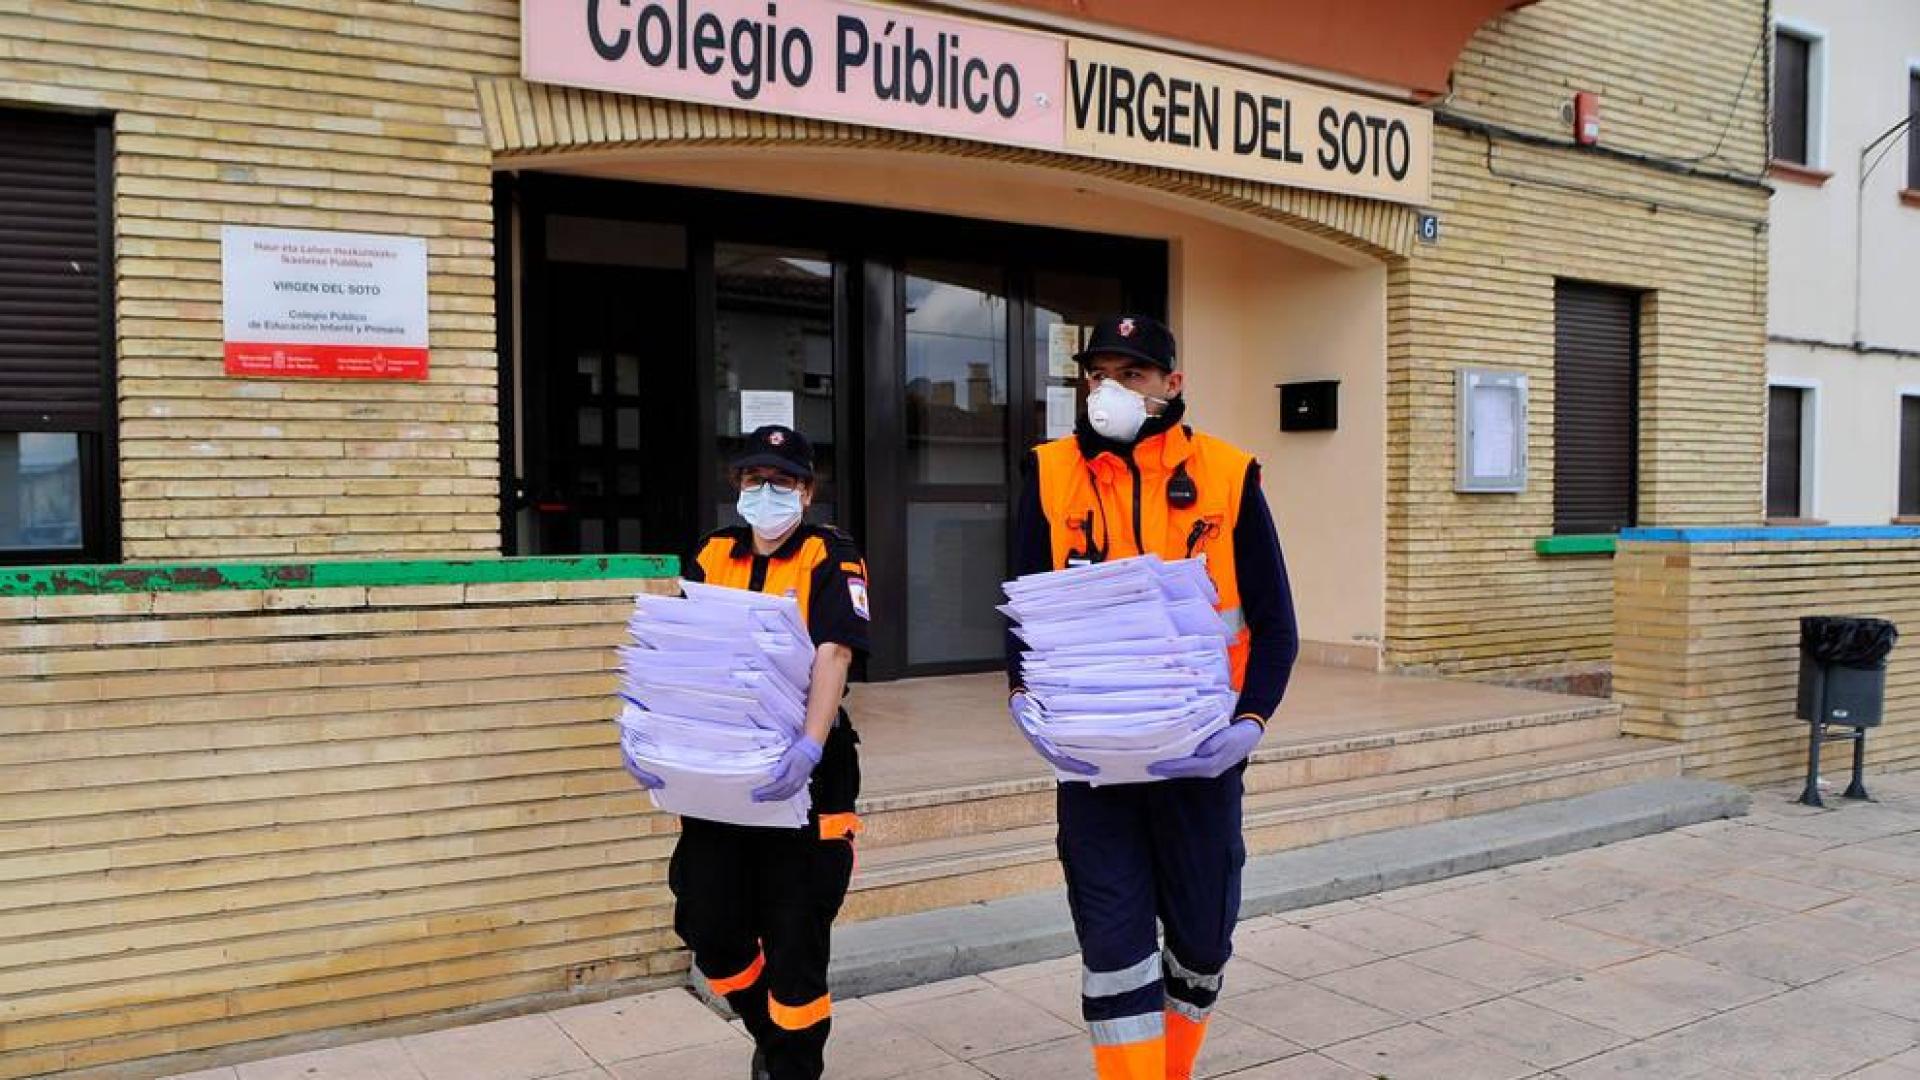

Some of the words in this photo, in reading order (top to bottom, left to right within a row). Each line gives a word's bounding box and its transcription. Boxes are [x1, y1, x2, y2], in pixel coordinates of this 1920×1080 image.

[586, 0, 813, 100] Colegio
[836, 14, 1021, 119] Público
[1069, 58, 1220, 151] VIRGEN
[1233, 90, 1304, 164] DEL
[1317, 106, 1411, 181] SOTO
[1425, 218, 1434, 238] 6
[273, 280, 319, 293] VIRGEN
[321, 283, 345, 295] DEL
[347, 284, 381, 296] SOTO
[248, 320, 261, 330] de
